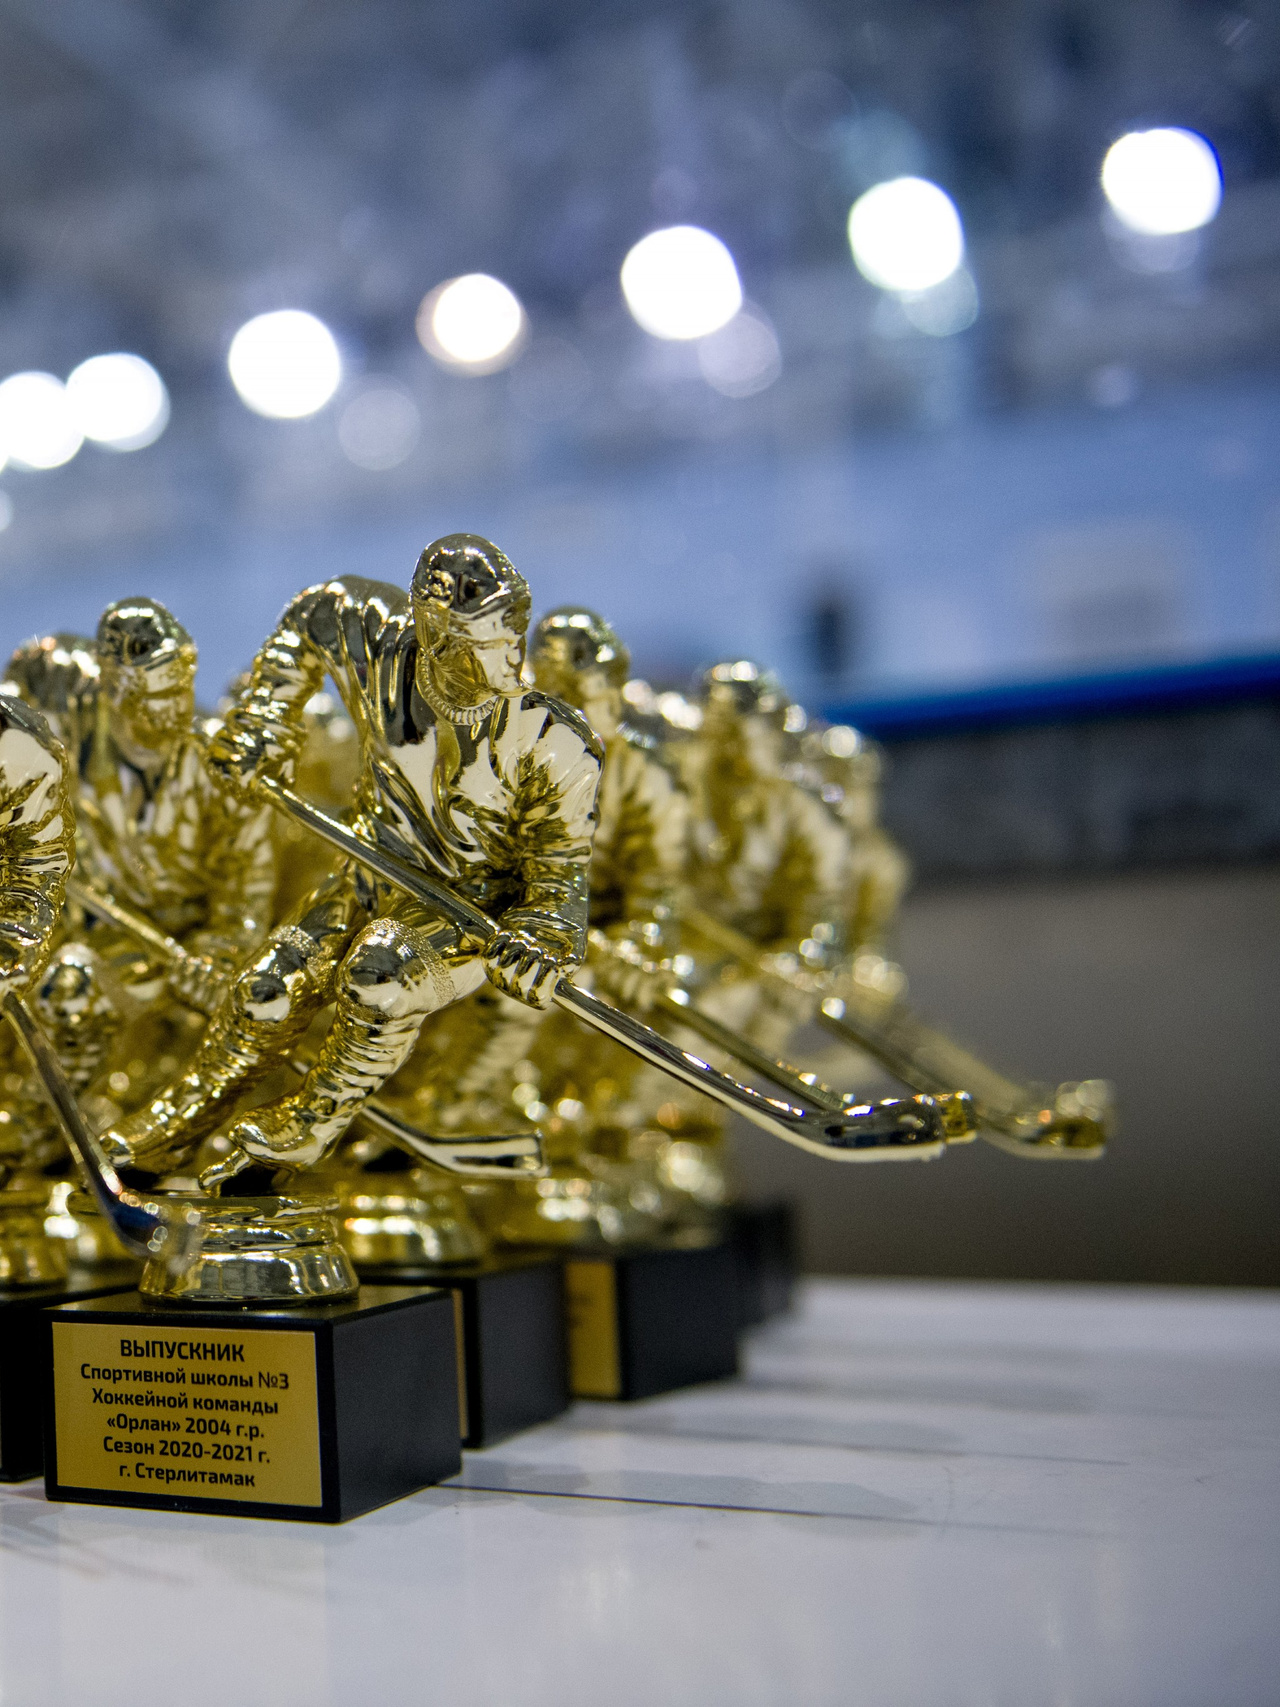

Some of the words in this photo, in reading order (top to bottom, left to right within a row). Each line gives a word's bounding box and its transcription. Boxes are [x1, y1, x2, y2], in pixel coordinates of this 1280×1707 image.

[120, 1339, 245, 1362] ВЫПУСКНИК
[80, 1363, 186, 1385] Спортивной
[191, 1372, 253, 1387] школы
[258, 1371, 290, 1390] №3
[92, 1387, 188, 1409] Хоккейной
[193, 1397, 278, 1414] команды
[107, 1413, 181, 1434] «Орлан»
[185, 1417, 231, 1437] 2004
[236, 1423, 265, 1441] г.р.
[103, 1436, 155, 1455] Сезон
[159, 1439, 253, 1462] 2020-2021
[258, 1449, 270, 1463] г.
[119, 1464, 131, 1478] г.
[135, 1463, 255, 1488] Стерлитамак
